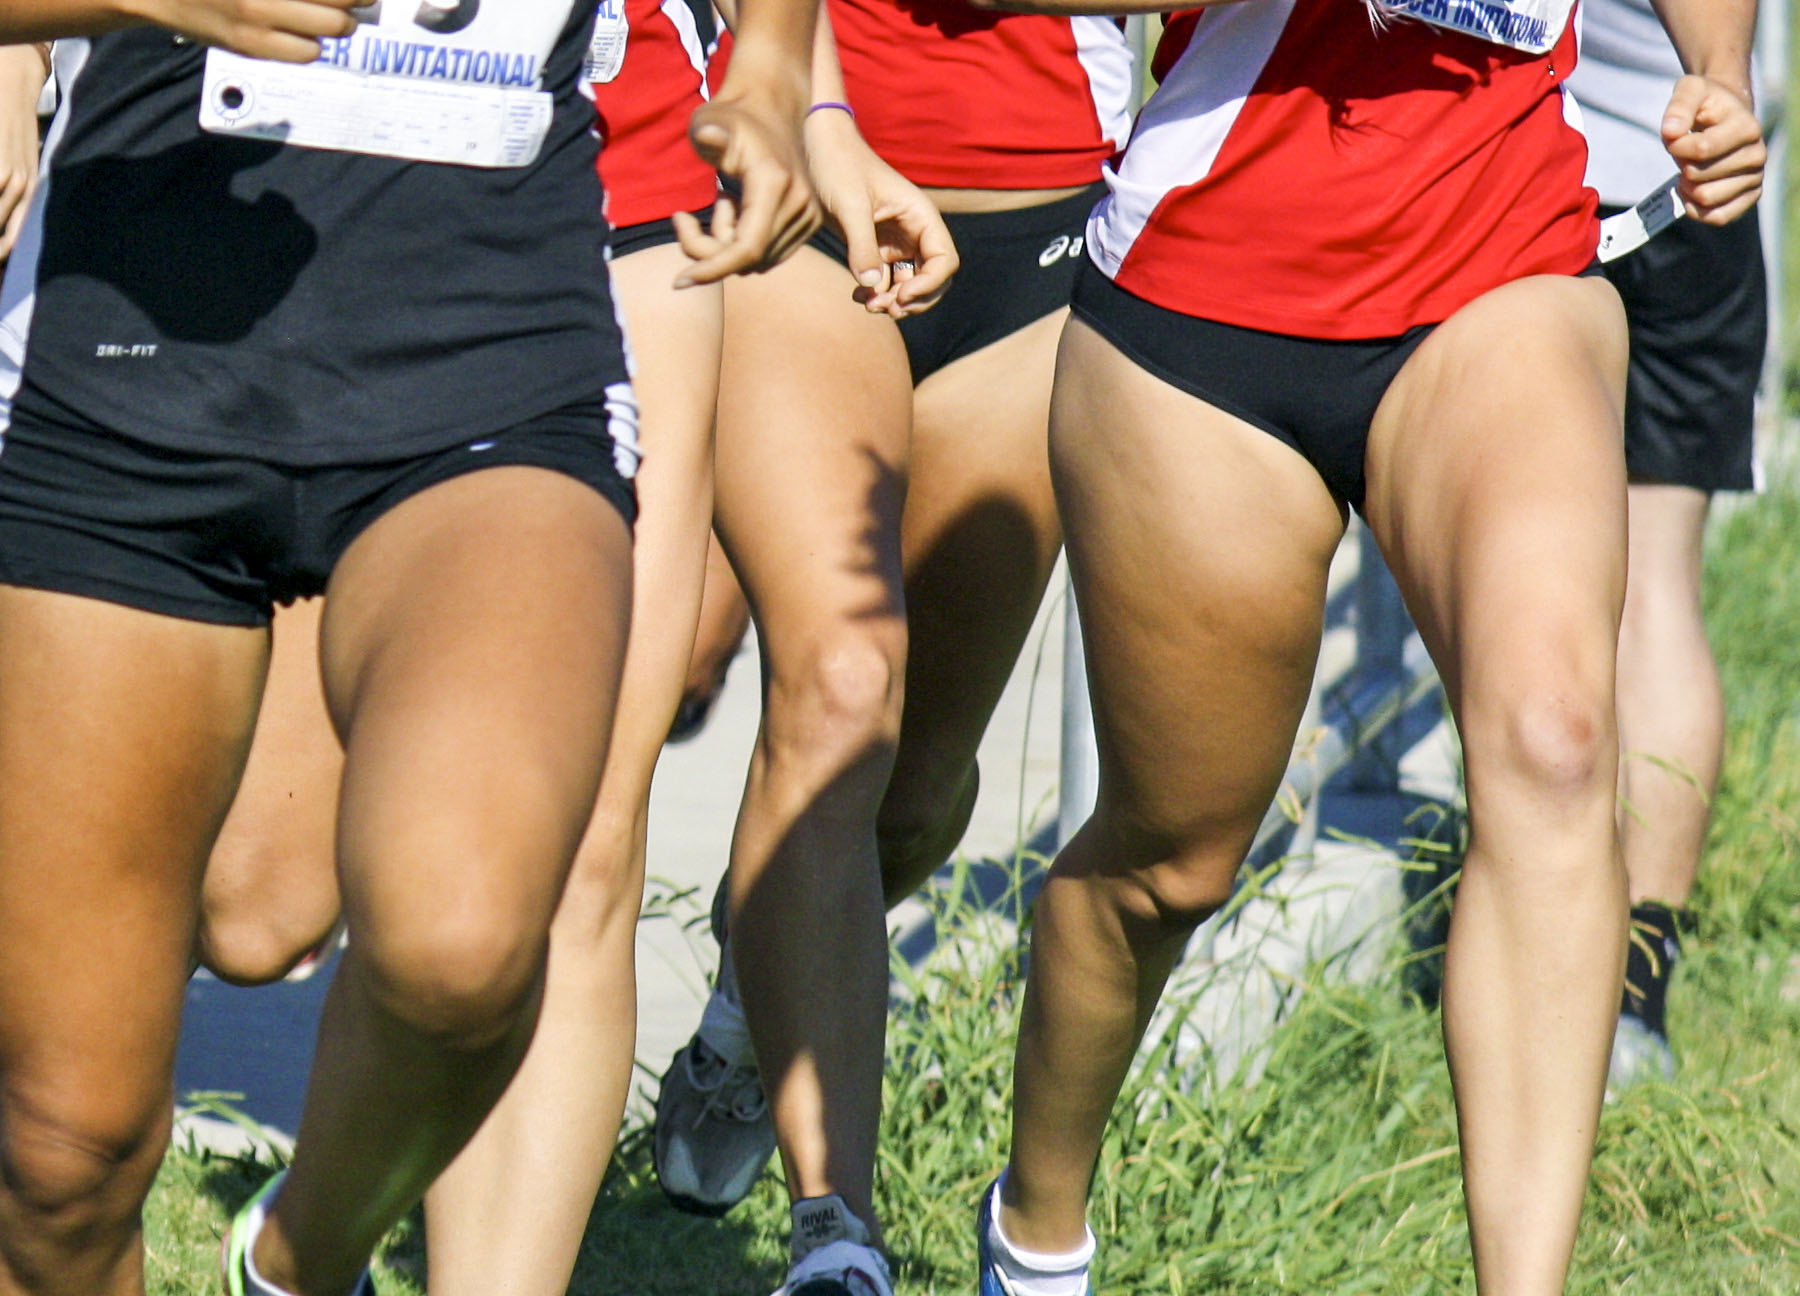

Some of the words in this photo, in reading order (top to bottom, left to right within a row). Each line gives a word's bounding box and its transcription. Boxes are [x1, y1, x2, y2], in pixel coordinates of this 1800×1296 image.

[361, 36, 536, 88] INVITATIONAL
[96, 344, 157, 357] DRI-FIT
[801, 1207, 839, 1230] RIVAL
